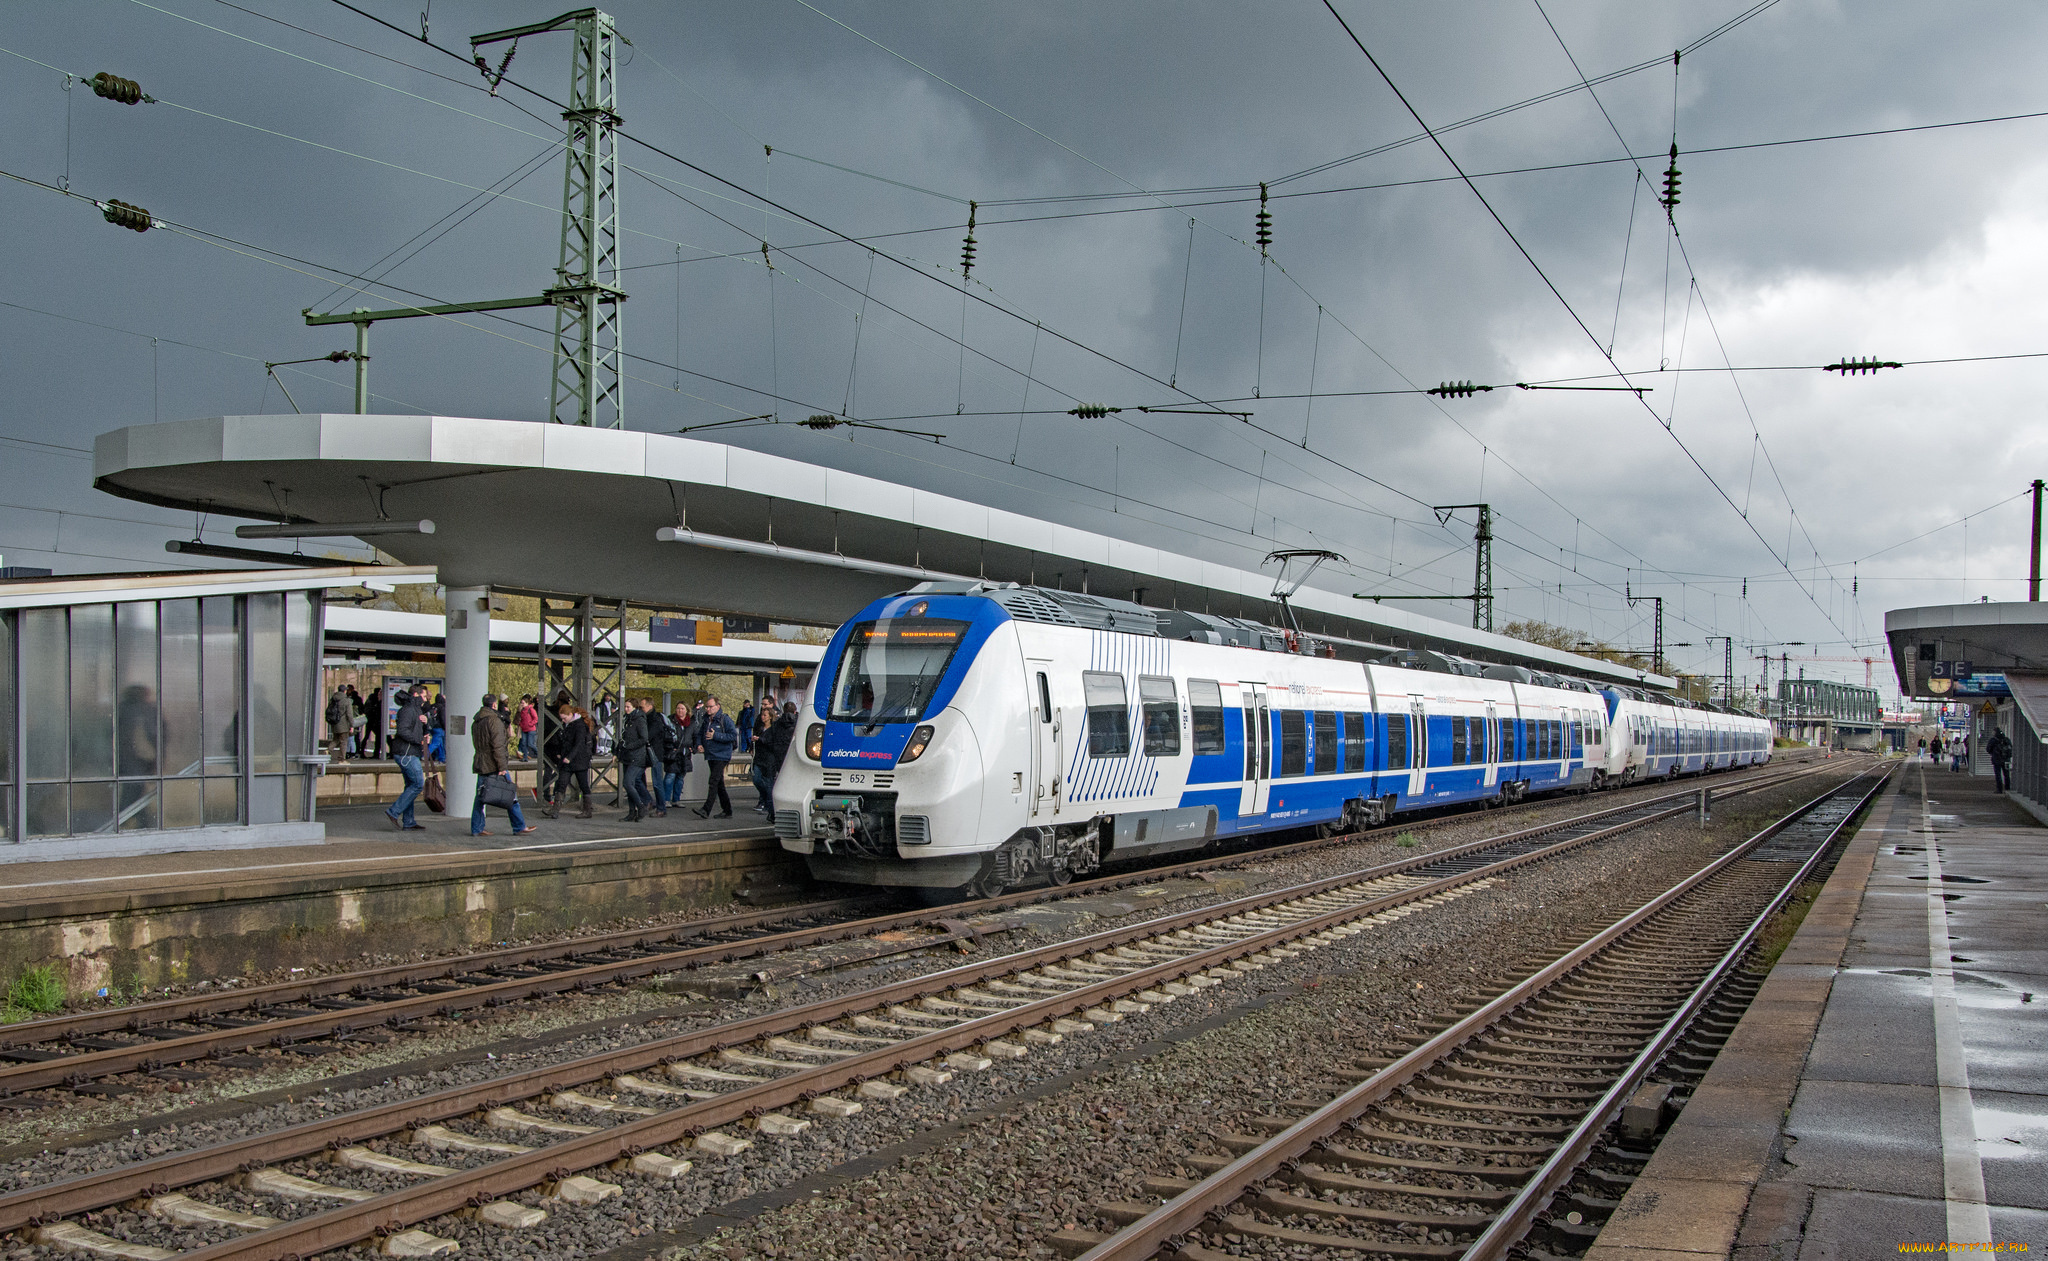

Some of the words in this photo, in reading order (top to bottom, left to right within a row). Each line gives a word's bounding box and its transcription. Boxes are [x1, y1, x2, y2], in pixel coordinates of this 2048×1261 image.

[1934, 661, 1944, 676] 5
[1955, 661, 1965, 676] E
[828, 748, 860, 758] national
[859, 751, 893, 760] express
[850, 774, 865, 784] 652
